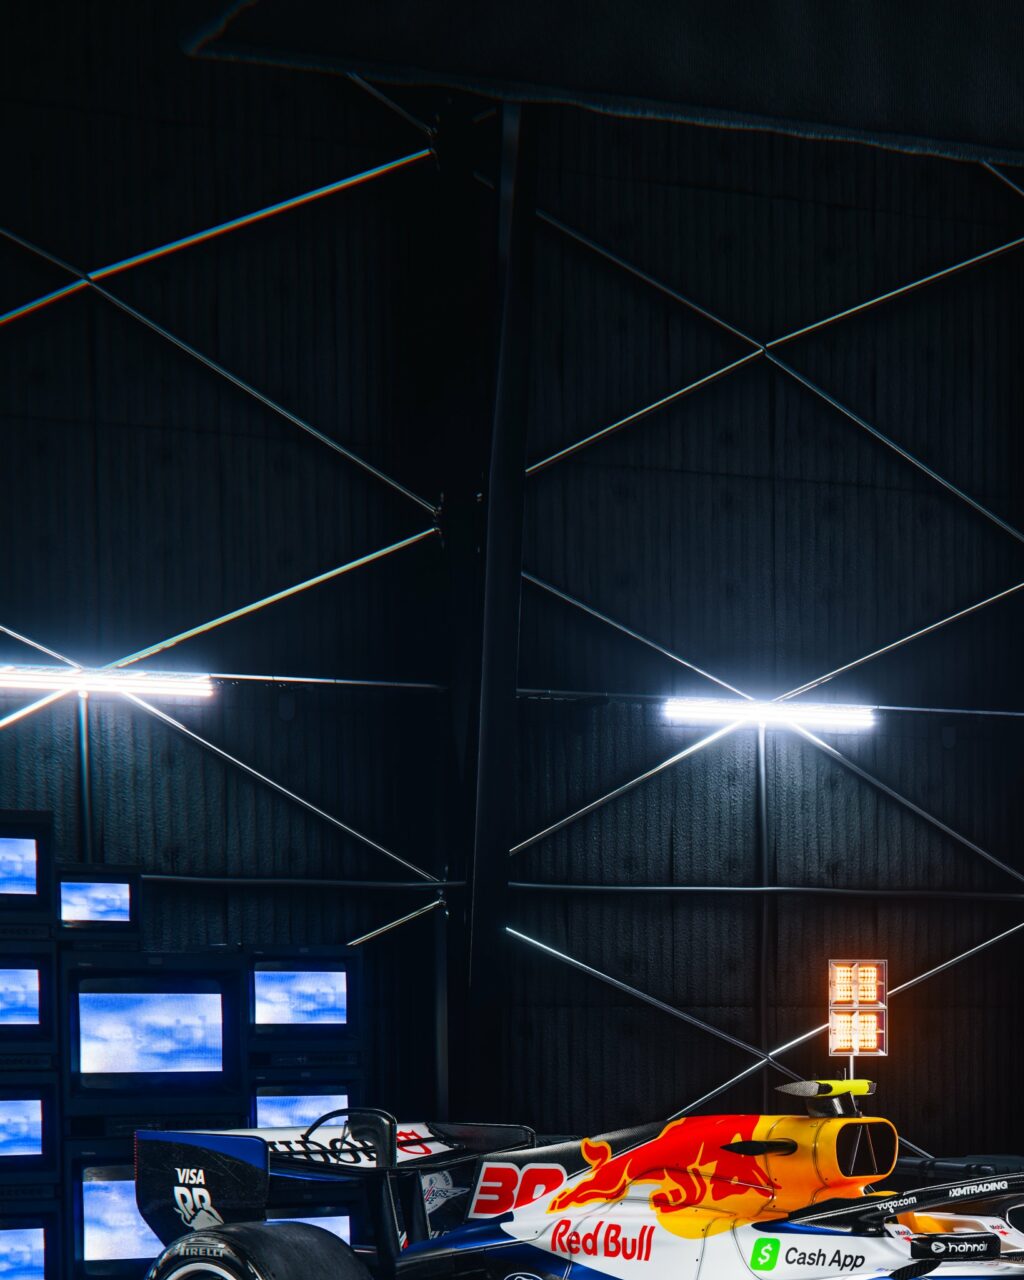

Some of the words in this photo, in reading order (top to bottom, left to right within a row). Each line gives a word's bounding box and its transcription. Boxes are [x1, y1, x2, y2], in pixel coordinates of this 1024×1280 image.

[174, 1167, 206, 1185] VISA
[177, 1243, 226, 1258] PIRELLI
[551, 1219, 605, 1257] Red
[603, 1223, 656, 1262] Bull
[785, 1247, 827, 1266] Cash
[828, 1249, 866, 1272] App
